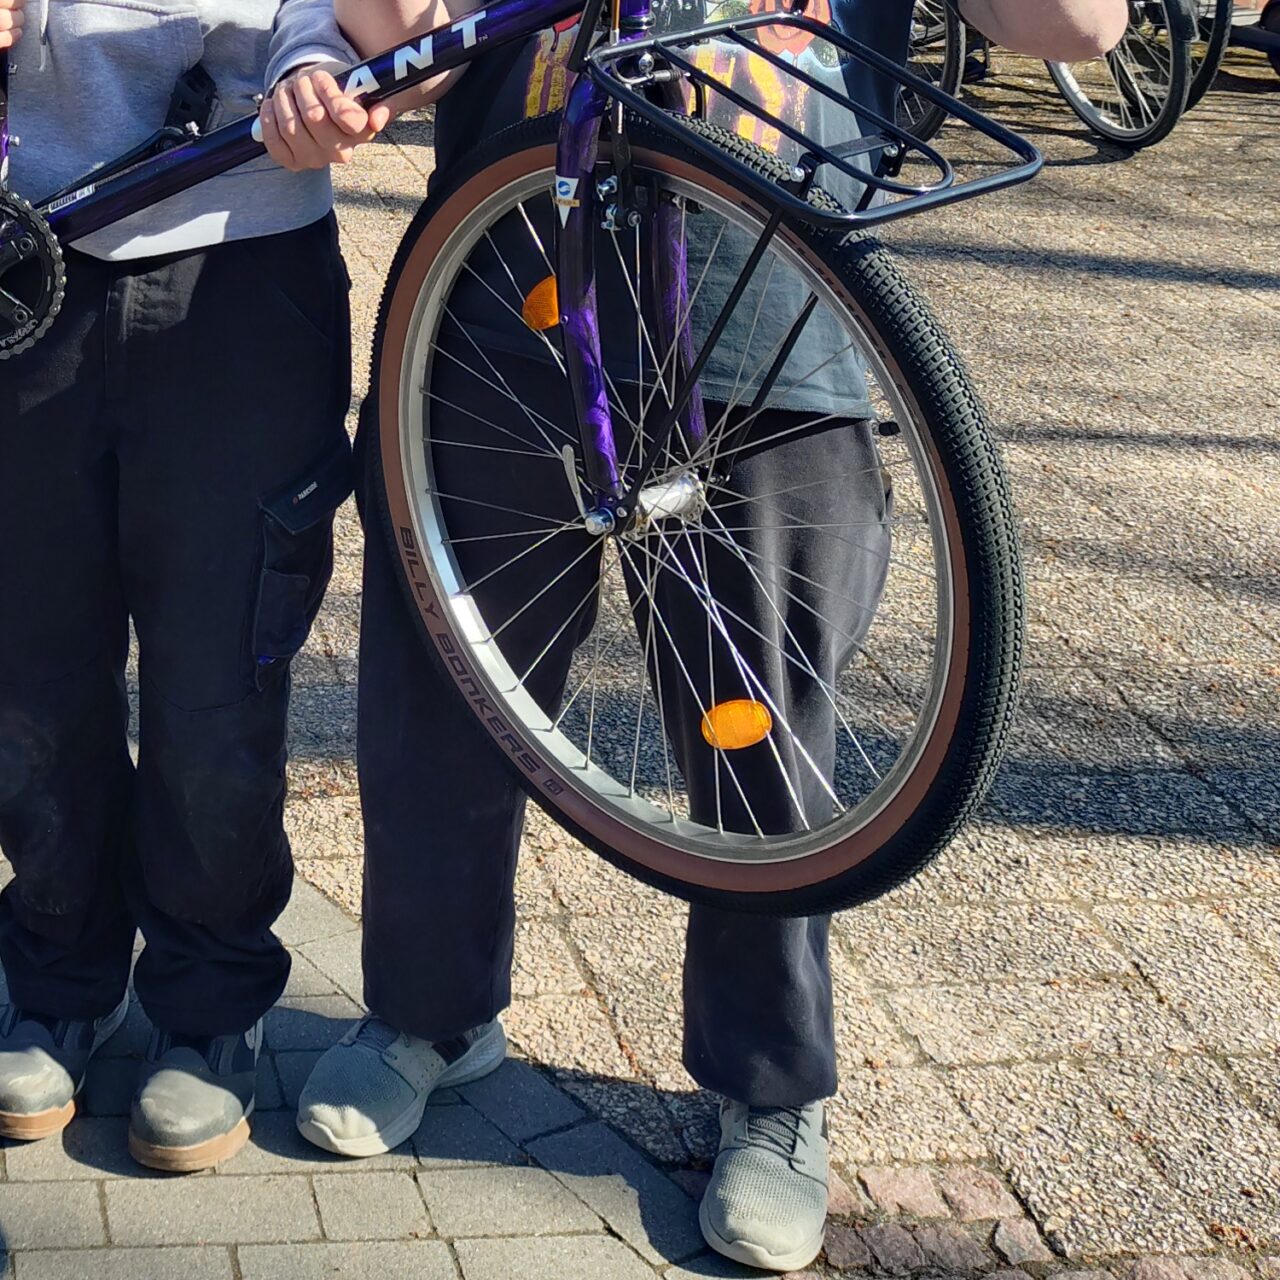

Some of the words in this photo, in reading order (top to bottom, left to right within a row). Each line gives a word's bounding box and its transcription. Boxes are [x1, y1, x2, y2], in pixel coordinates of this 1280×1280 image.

[344, 10, 487, 99] ANT
[399, 526, 441, 620] BILLY
[435, 632, 542, 775] BONKERS
